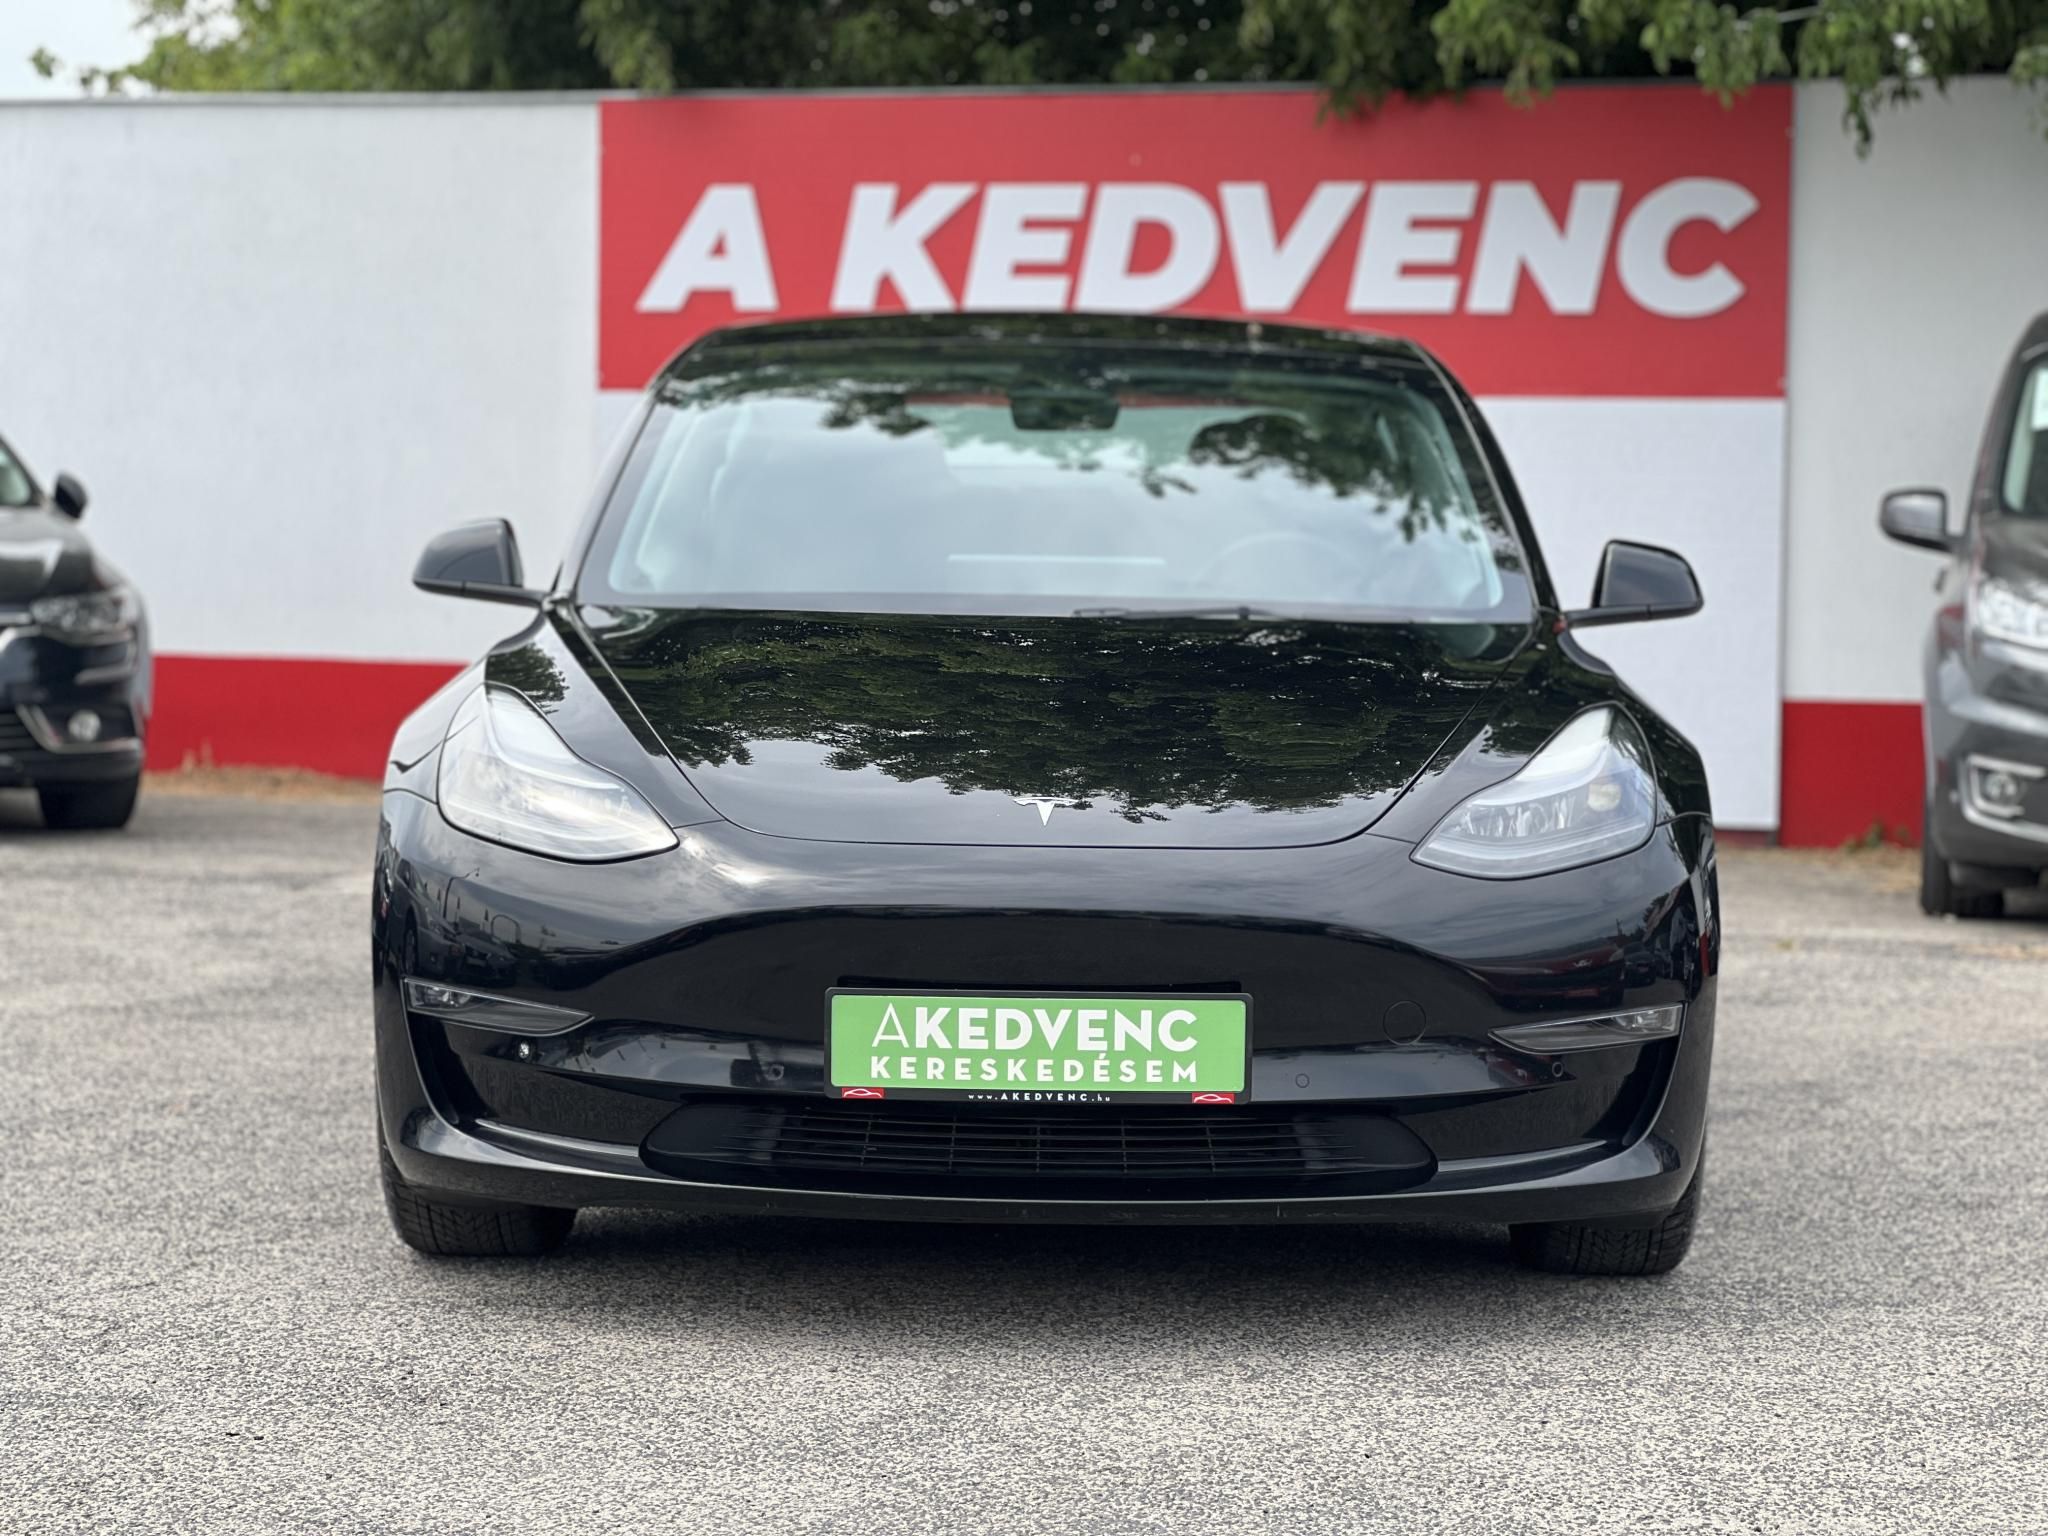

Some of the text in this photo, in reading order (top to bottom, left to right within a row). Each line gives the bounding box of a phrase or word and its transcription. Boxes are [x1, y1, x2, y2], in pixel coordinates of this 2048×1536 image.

[636, 178, 1760, 319] A KEDVENC
[870, 1053, 1198, 1084] KERESKEDÉSEM
[968, 1092, 1111, 1103] www.AKEDVENC.hu
